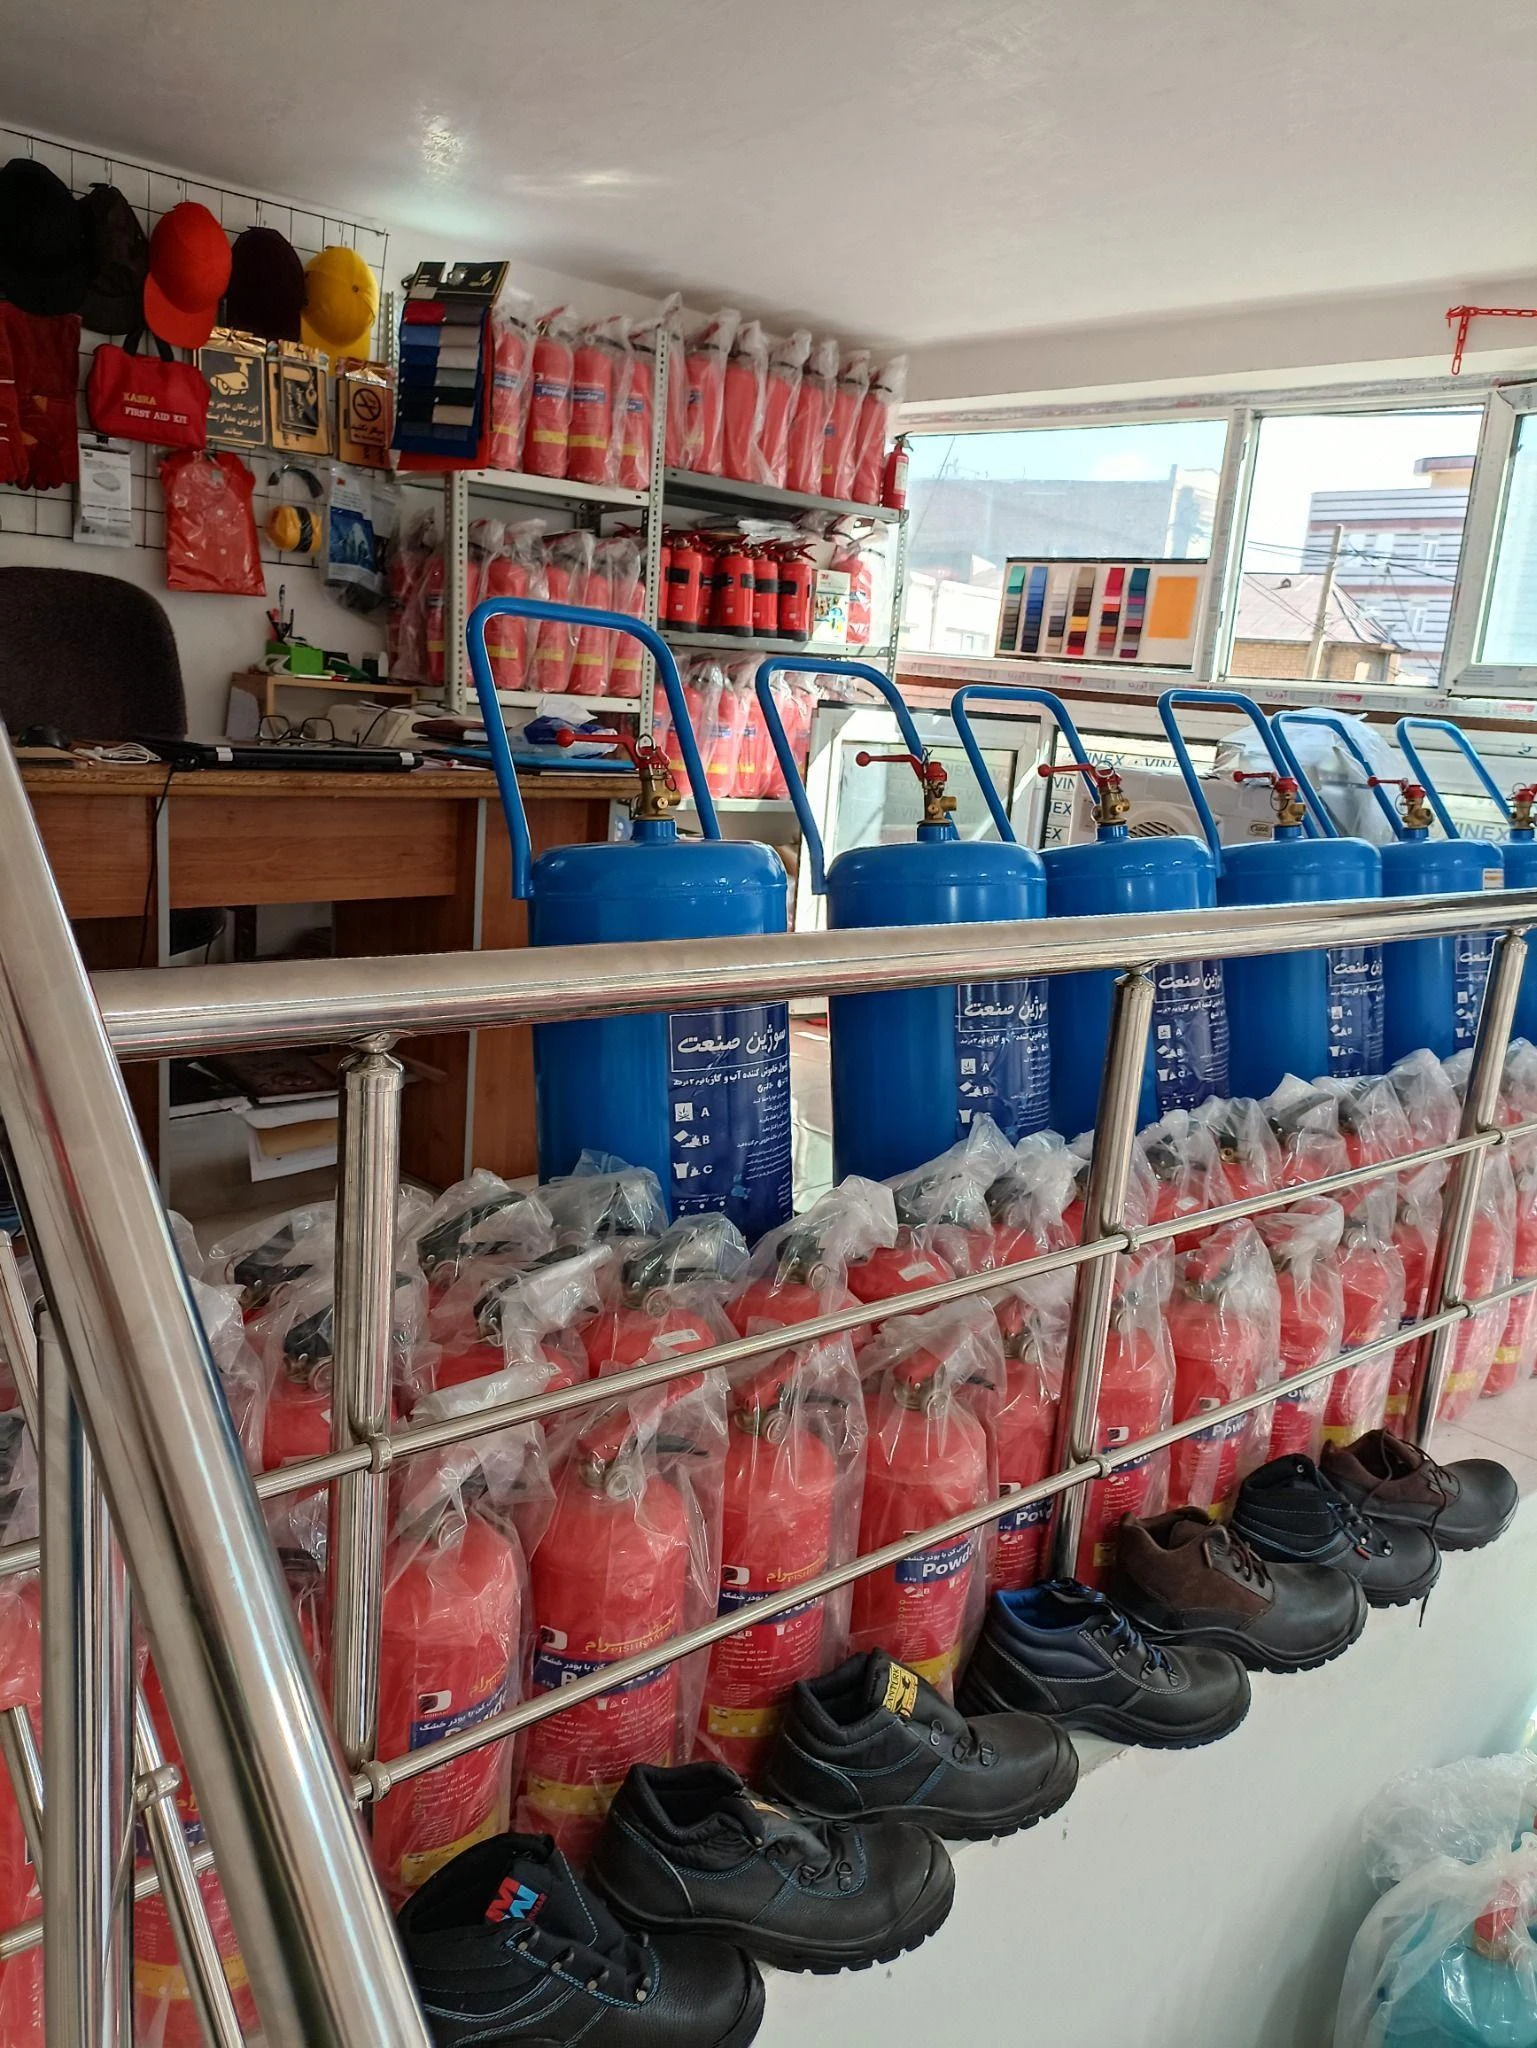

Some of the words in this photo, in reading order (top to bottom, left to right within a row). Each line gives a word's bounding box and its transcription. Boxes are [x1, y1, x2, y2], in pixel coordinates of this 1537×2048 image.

[123, 392, 157, 405] KASRA
[124, 406, 150, 418] FIRST
[153, 411, 170, 422] AID
[173, 414, 188, 425] KIT
[1333, 959, 1370, 975] صنعت
[1158, 974, 1201, 990] صنعت
[964, 1002, 1015, 1017] صنعت
[1176, 1028, 1183, 1036] A
[677, 1033, 741, 1054] صنعت
[746, 1024, 786, 1055] سوژین
[982, 1062, 991, 1072] A
[729, 1070, 742, 1081] آب
[742, 1068, 760, 1079] کننده
[709, 1073, 722, 1086] گاز
[724, 1076, 729, 1084] و
[982, 1086, 990, 1095] B
[701, 1107, 710, 1118] A
[702, 1135, 710, 1145] B
[703, 1165, 713, 1174] C
[564, 1662, 582, 1671] پودر
[621, 1697, 629, 1705] C
[419, 1720, 447, 1731] خشک
[447, 1715, 466, 1728] پودر
